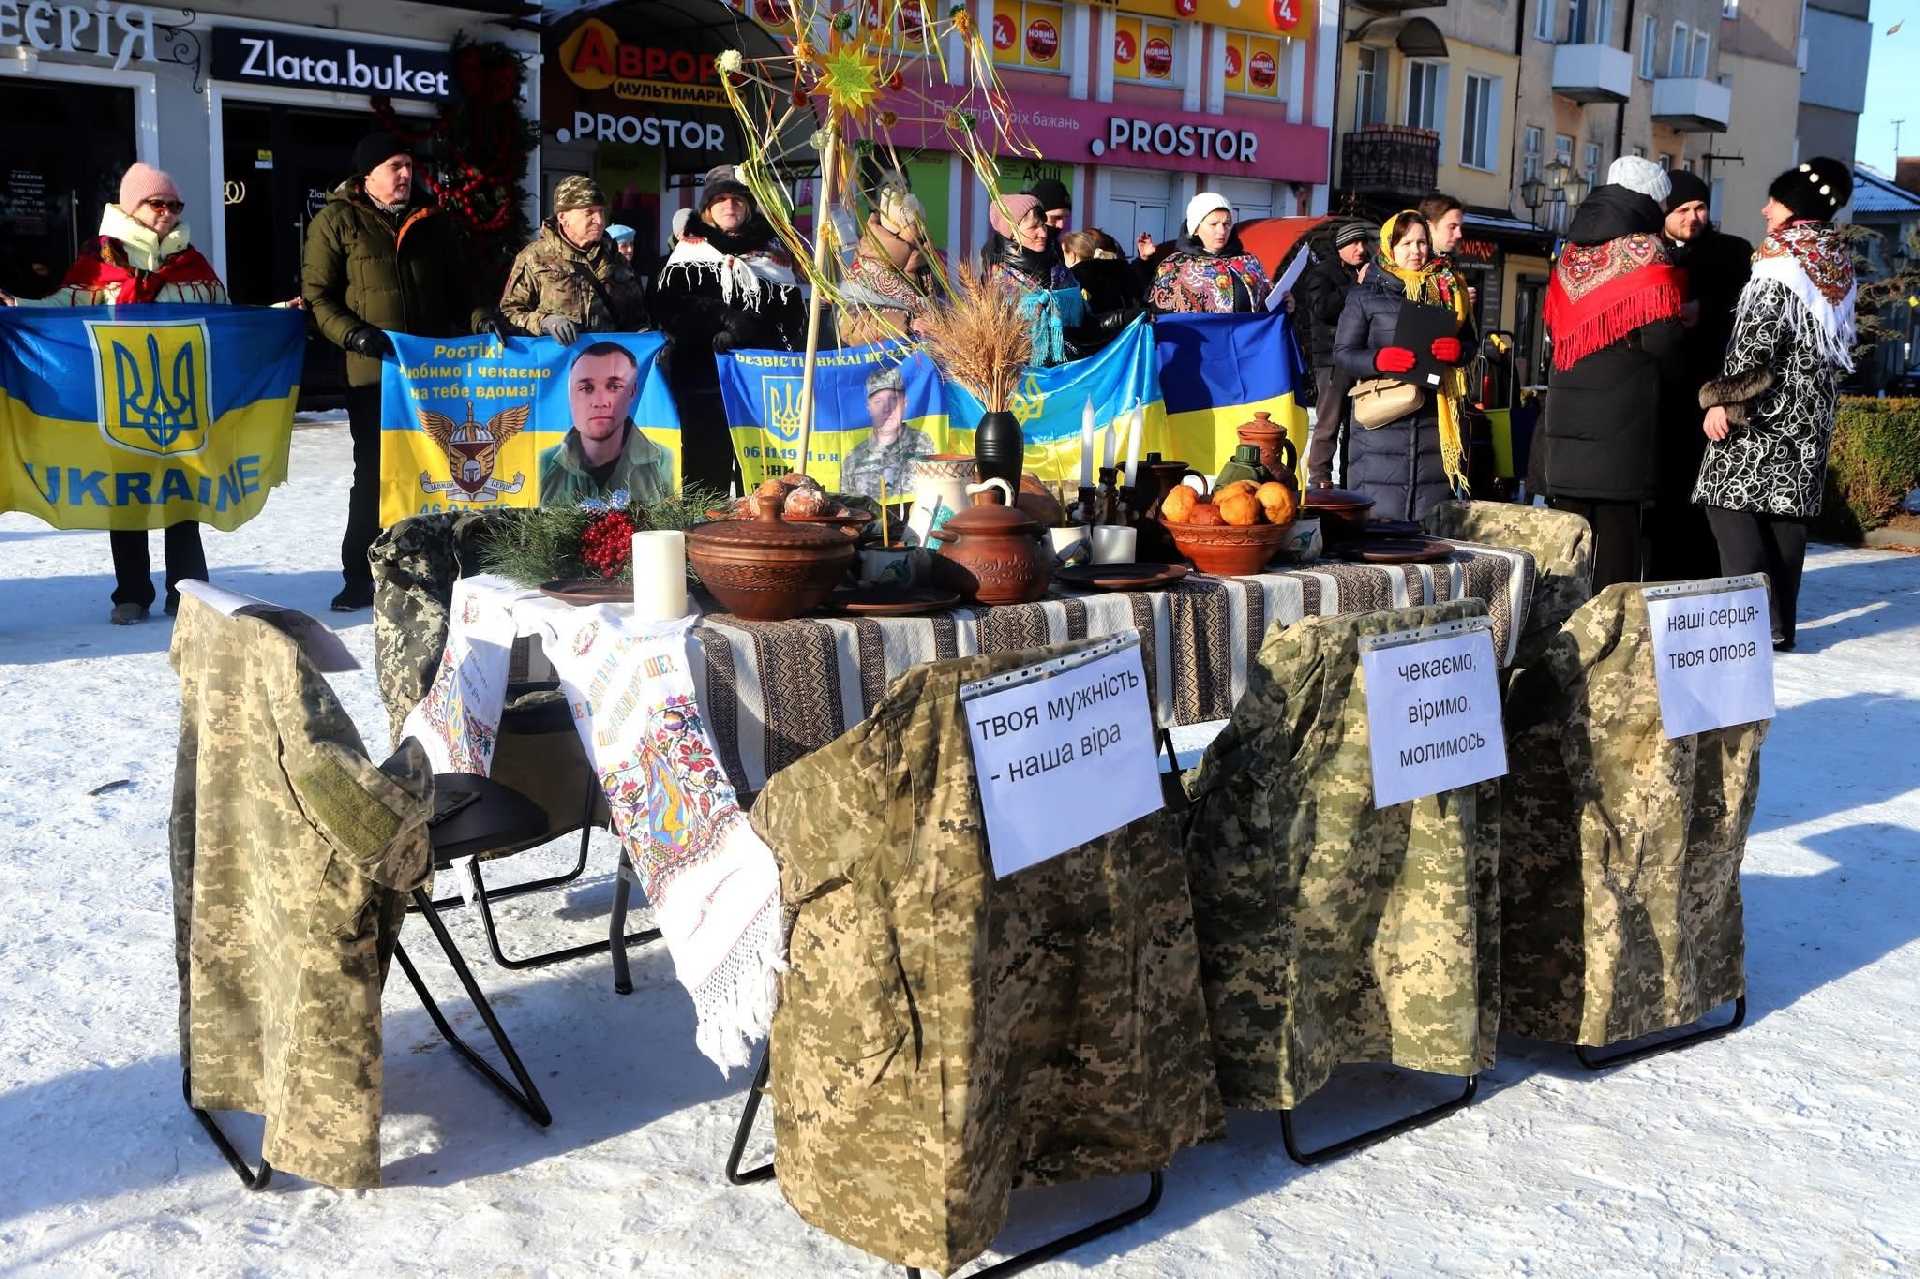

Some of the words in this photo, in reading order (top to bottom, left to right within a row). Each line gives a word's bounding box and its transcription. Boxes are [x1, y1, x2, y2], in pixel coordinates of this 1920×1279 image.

[239, 38, 449, 96] Zlata.buket
[572, 26, 752, 88] АВРОР
[1032, 111, 1080, 130] бажань
[434, 342, 505, 359] Ростік!
[816, 353, 862, 368] НИКЛІ
[466, 362, 473, 378] і
[478, 366, 551, 379] чекаємо
[411, 386, 429, 400] на
[432, 383, 470, 399] тебе
[475, 384, 536, 400] вдома!
[743, 446, 812, 461] 06.11.191
[24, 455, 261, 513] UKRAINE
[1667, 607, 1705, 632] наші
[1709, 606, 1759, 629] серця-
[1398, 653, 1477, 682] чекаємо,
[1669, 649, 1704, 669] твоя
[1709, 641, 1756, 664] опора
[976, 706, 1039, 740] твоя
[1048, 669, 1140, 722] мужність
[1008, 742, 1075, 782] наша
[1080, 723, 1122, 757] віра
[1400, 732, 1486, 768] молимось
